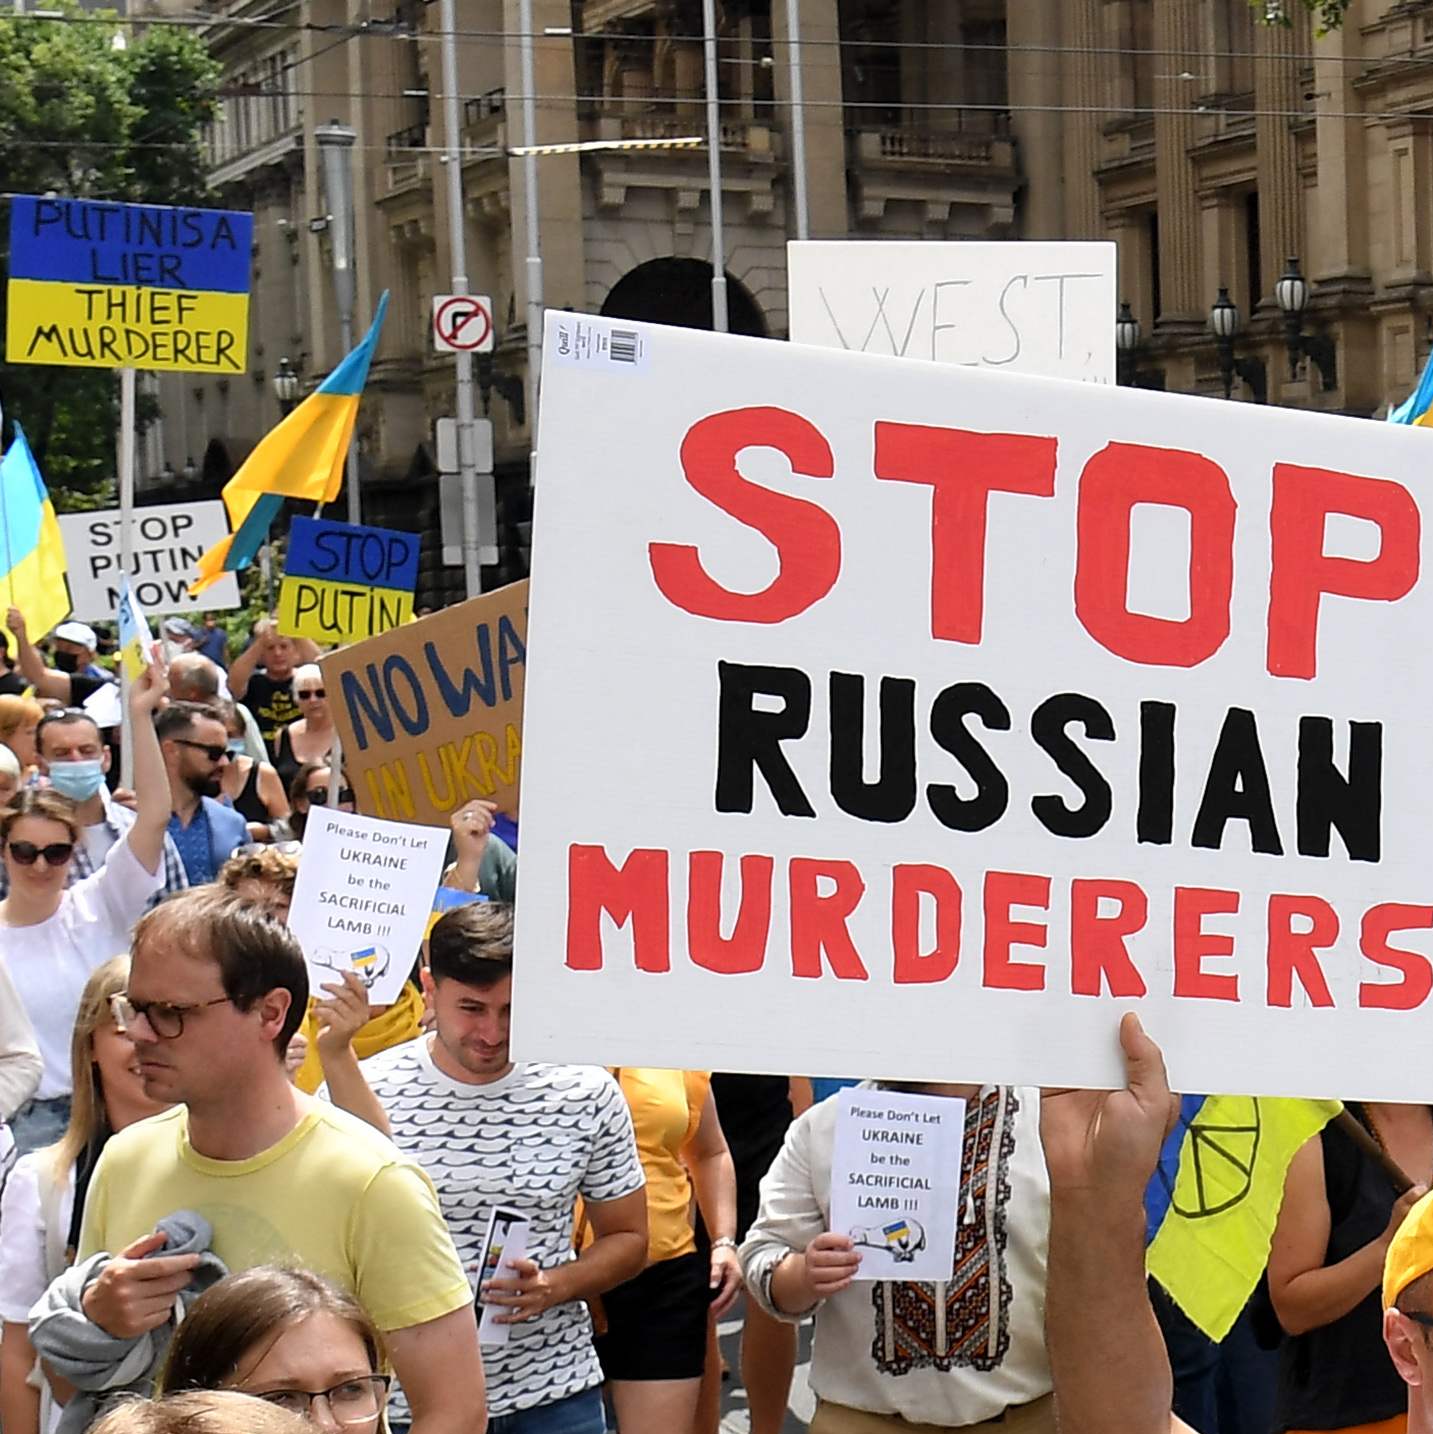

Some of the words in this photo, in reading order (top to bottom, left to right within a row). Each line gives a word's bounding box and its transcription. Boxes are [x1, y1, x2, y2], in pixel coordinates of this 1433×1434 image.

[90, 248, 188, 287] LIER
[27, 324, 241, 370] MURDERER
[88, 514, 193, 546] SOP
[647, 403, 1421, 680] STOP
[308, 530, 410, 581] STOP
[340, 654, 429, 751] NO
[423, 610, 528, 718] WA
[714, 659, 1383, 863] RUSSIAN
[364, 758, 416, 820] IN
[326, 822, 369, 840] Please
[372, 831, 408, 847] Don't
[409, 836, 429, 850] Let
[339, 847, 409, 871] UKRAINE
[347, 873, 365, 887] be
[368, 875, 391, 891] the
[318, 890, 406, 916] SACRIFICIAL
[327, 915, 372, 935] LAMB
[850, 1105, 884, 1121] Please
[886, 1109, 920, 1123] Don't
[922, 1113, 941, 1125] Let
[861, 1128, 924, 1146] UKRAINE
[870, 1152, 886, 1165] be
[889, 1153, 911, 1166] the
[848, 1172, 932, 1191] SACRIFICIAL
[857, 1195, 900, 1211] LAMB
